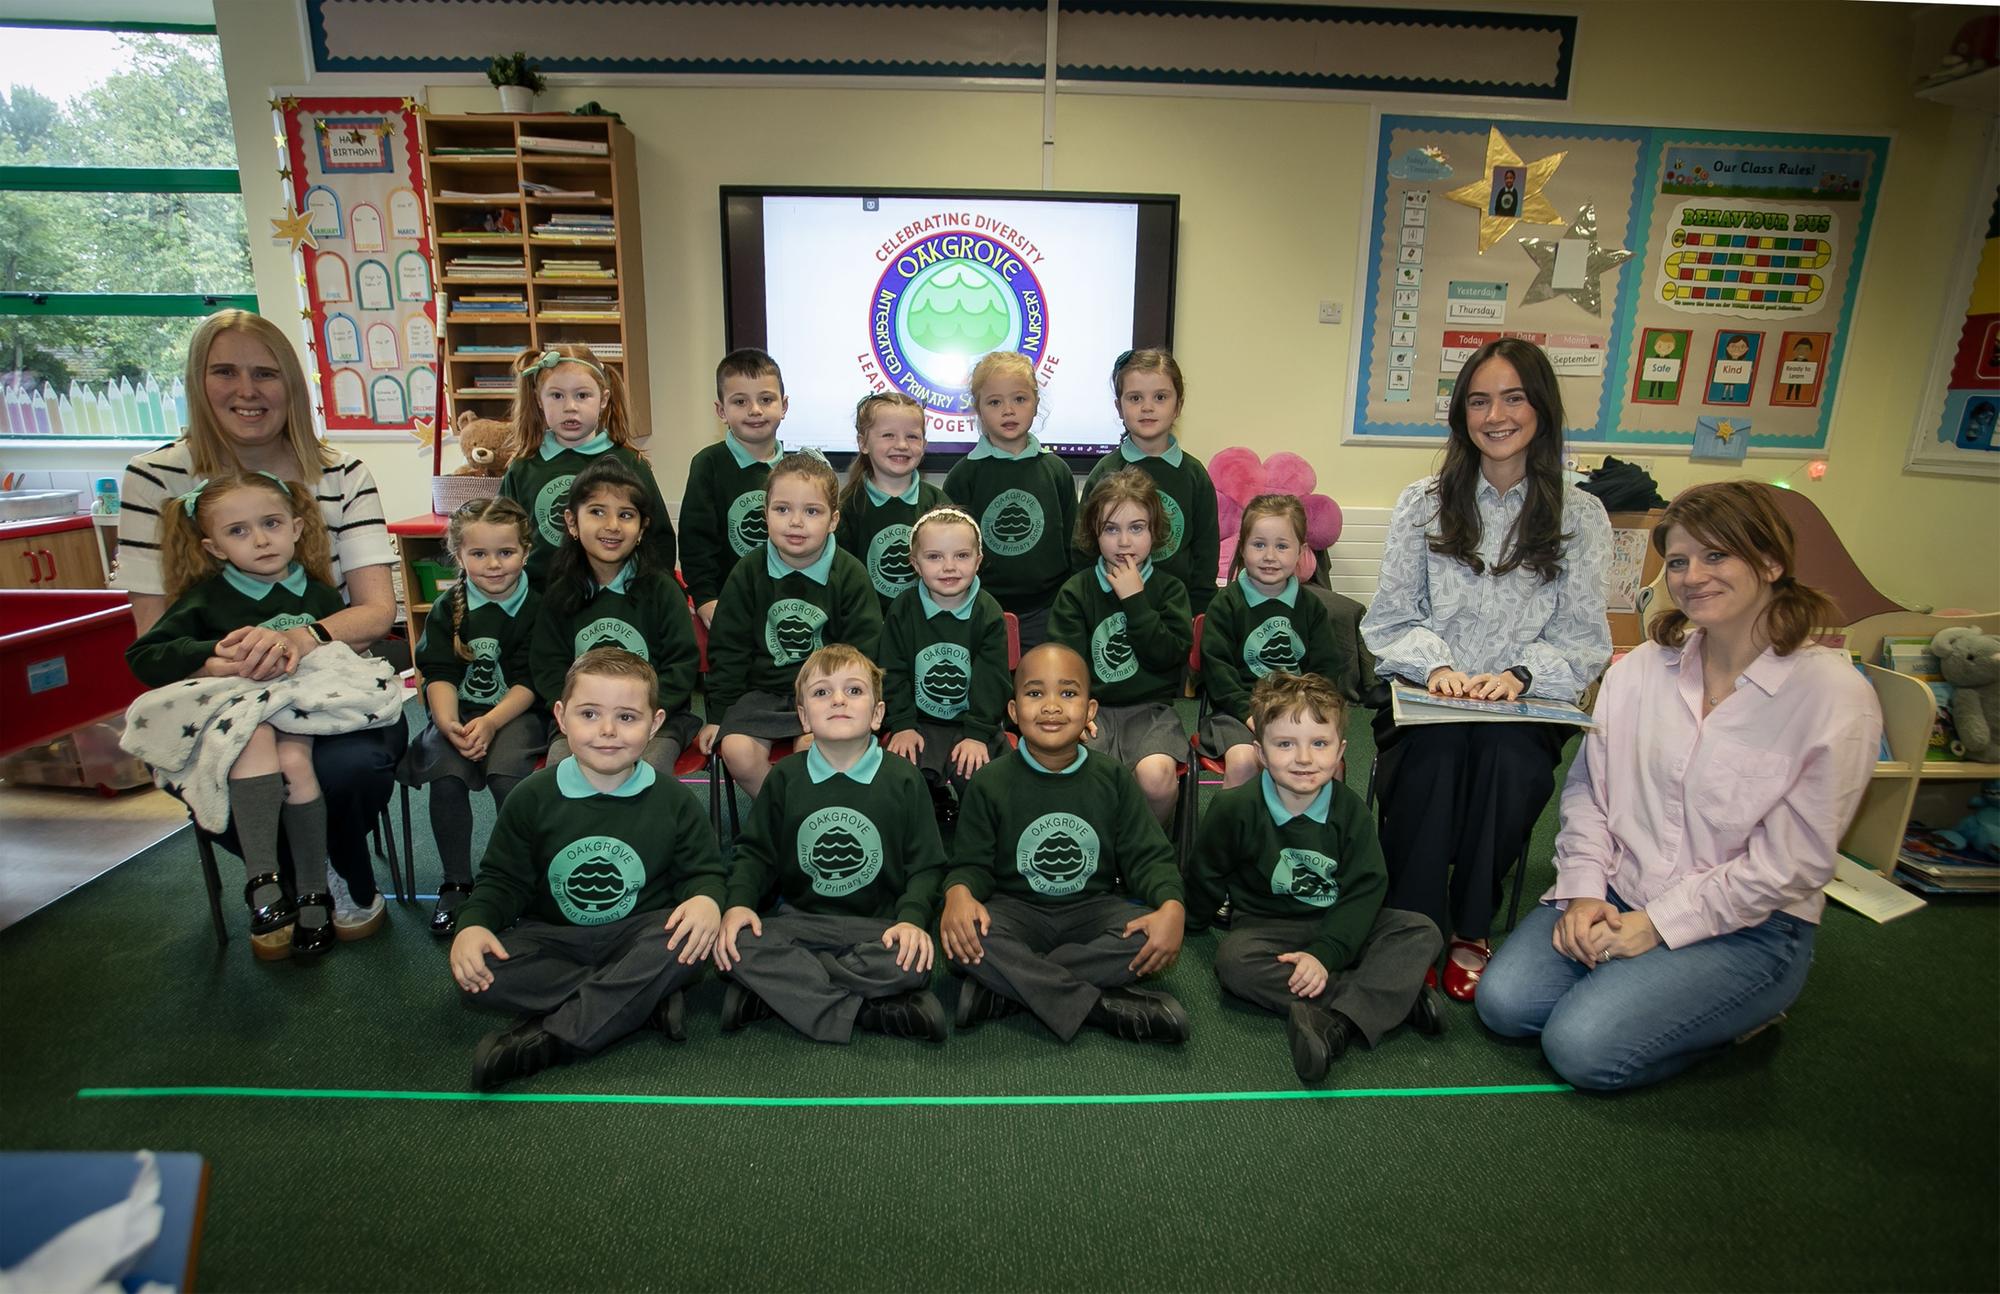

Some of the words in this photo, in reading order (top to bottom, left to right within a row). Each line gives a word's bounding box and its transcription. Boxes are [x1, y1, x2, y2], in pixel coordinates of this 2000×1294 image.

[333, 147, 378, 157] BIRTHDAY!
[1714, 160, 1737, 173] Our
[1741, 161, 1774, 175] Class
[1779, 163, 1815, 176] Rules!
[1681, 209, 1789, 231] BEHAVIOUR
[1794, 214, 1832, 233] BUS
[876, 213, 971, 262] CELEBRATING
[975, 214, 1045, 265] DIVERSITY
[897, 236, 1023, 282] OAKGROVE
[1457, 286, 1497, 298] Yesterday
[1458, 305, 1496, 318] Thursday
[1459, 335, 1484, 346] Today
[1516, 333, 1537, 342] Date
[1564, 336, 1590, 345] Month
[876, 289, 902, 375] INTEGRATED
[900, 372, 955, 409] PRIMARY
[1022, 291, 1042, 352] NURSERY
[1458, 351, 1470, 361] Fri
[1553, 355, 1596, 366] September
[1652, 364, 1672, 374] Safe
[1723, 365, 1743, 375] Kind
[1786, 366, 1806, 374] Ready
[857, 353, 889, 394] LEAR
[926, 416, 976, 433] TOGET
[1038, 354, 1061, 388] LIFE
[547, 479, 572, 495] OAKG
[739, 494, 764, 508] OAKG
[994, 492, 1036, 509] OAKGROVE
[877, 528, 912, 545] OAKGRO
[772, 603, 822, 621] OAKGROVE
[581, 622, 633, 642] OAKGROVE
[923, 647, 970, 665] OAKGROVE
[809, 812, 871, 836] OAKGROVE
[1031, 818, 1089, 838] OAKGROVE
[567, 841, 634, 865] OAKGROVE
[824, 877, 862, 893] Primary
[861, 849, 880, 880] School
[1021, 850, 1047, 890] Integted
[1048, 880, 1084, 894] Primary
[580, 910, 621, 924] Primary
[619, 880, 640, 910] Scol
